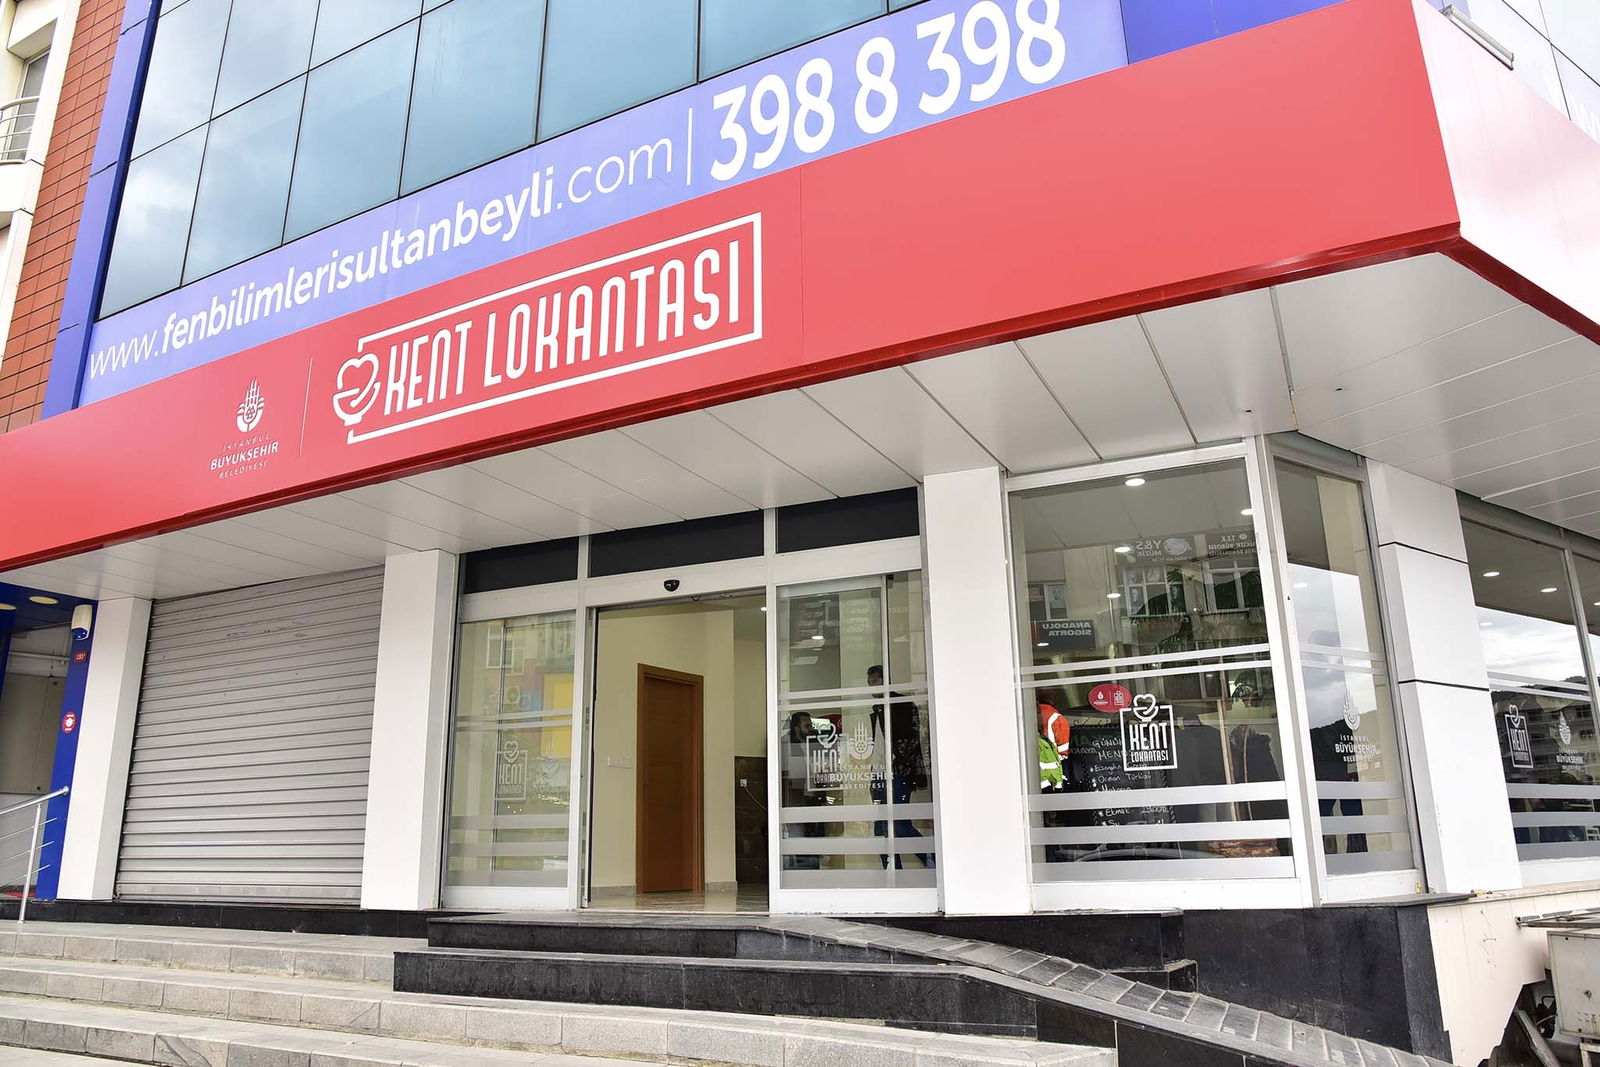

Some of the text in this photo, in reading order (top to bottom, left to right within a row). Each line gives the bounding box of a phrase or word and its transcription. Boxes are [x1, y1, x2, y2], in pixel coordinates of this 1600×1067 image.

[89, 0, 1066, 379] www.fenbilimlerisultanbeyli.com 398 8 398
[384, 240, 740, 416] KENT LOKANTASI
[1128, 722, 1168, 751] KENT
